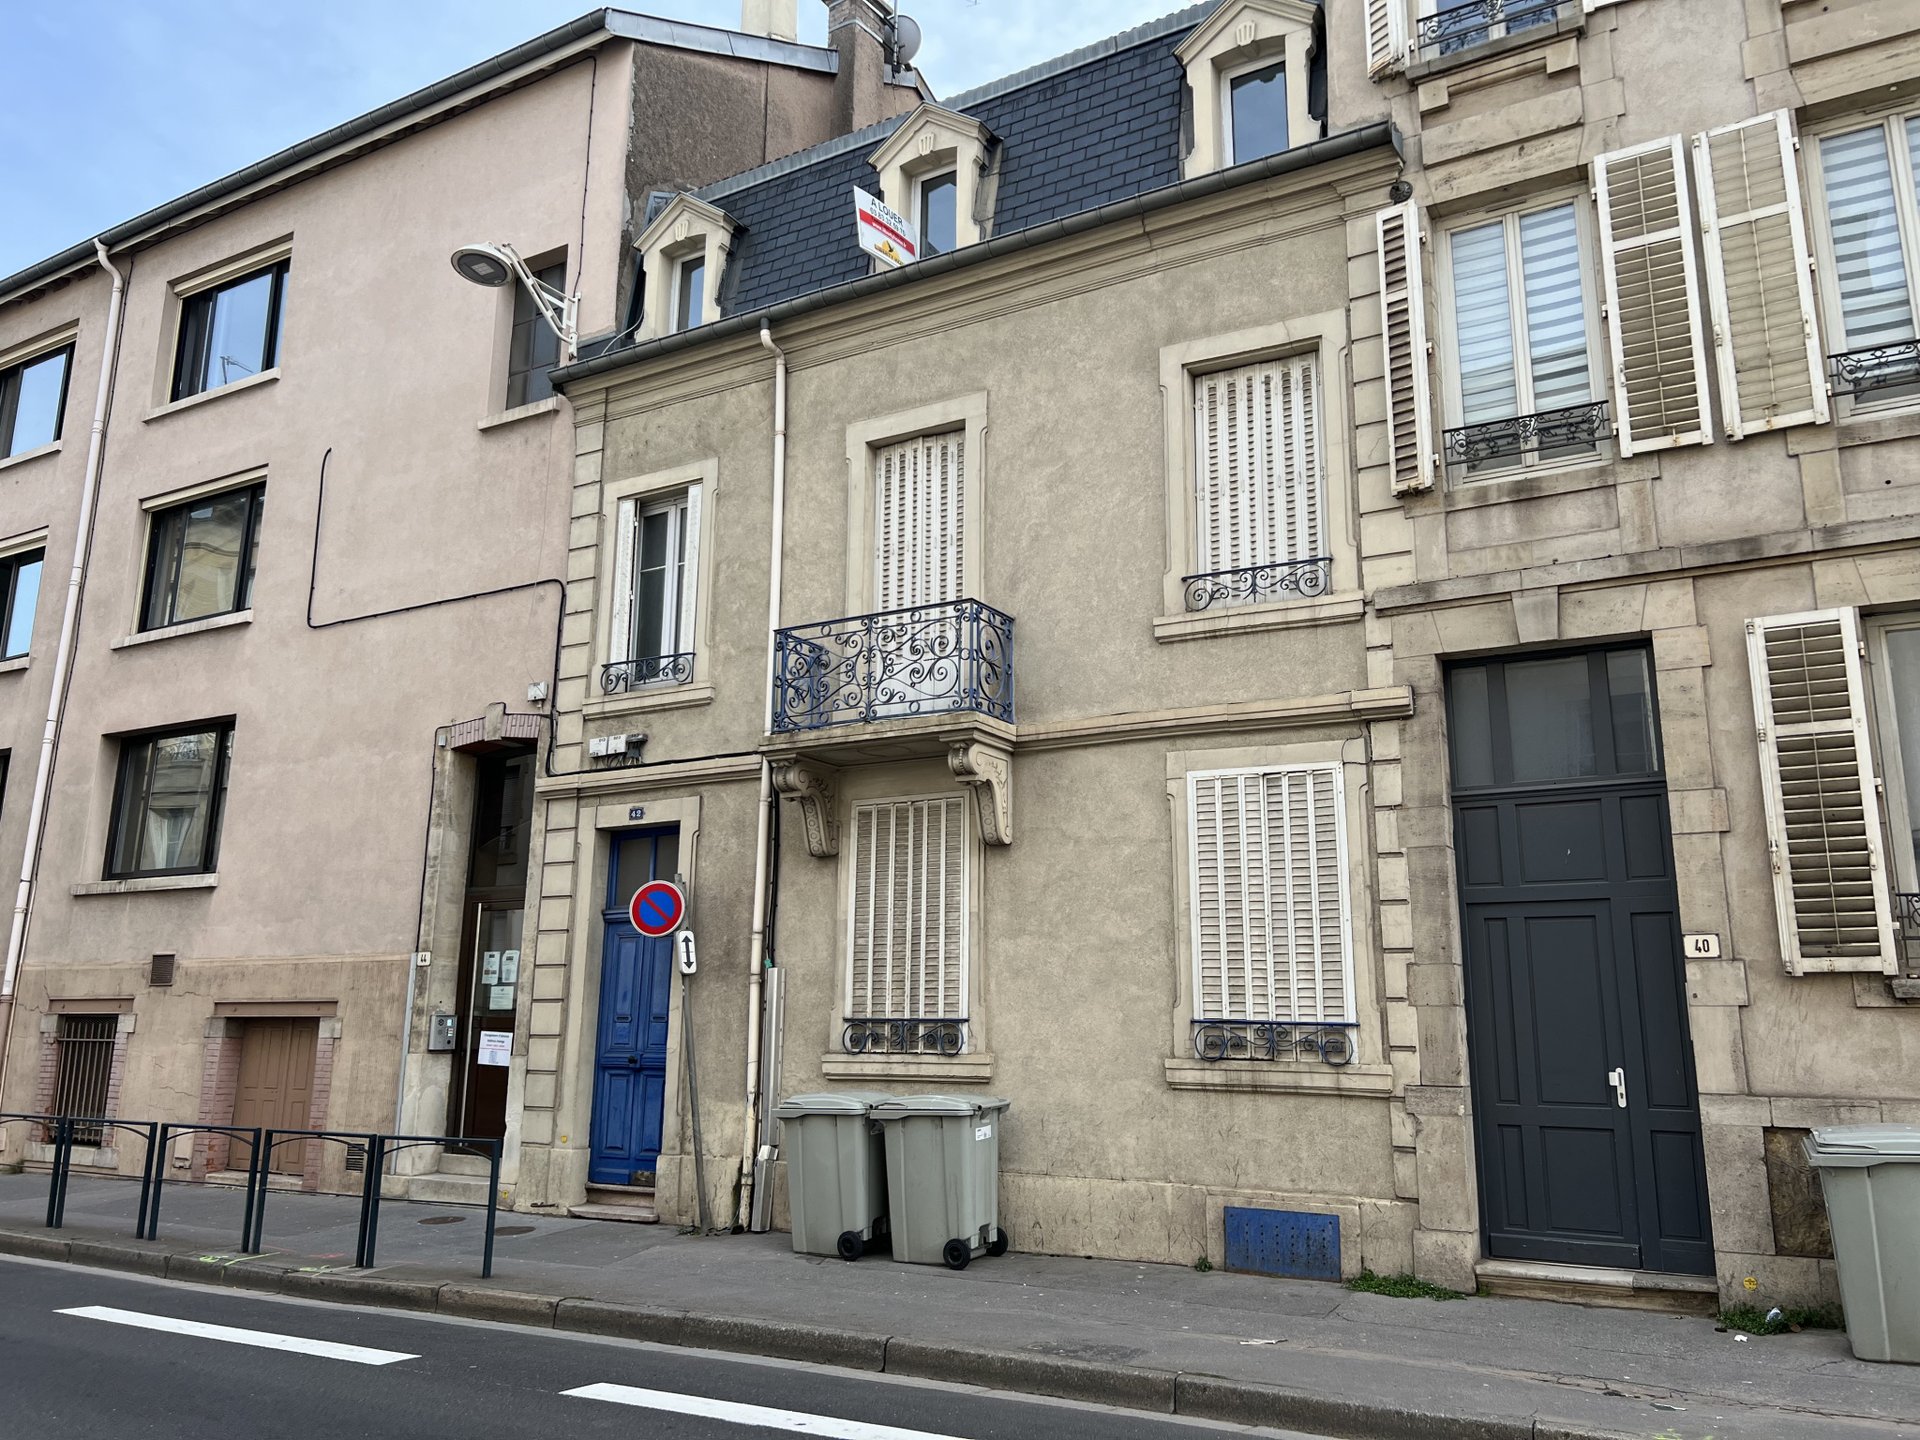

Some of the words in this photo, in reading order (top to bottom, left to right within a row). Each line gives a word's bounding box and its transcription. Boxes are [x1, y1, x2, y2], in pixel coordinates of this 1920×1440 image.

[871, 198, 877, 209] A
[878, 202, 904, 228] LOUER
[631, 809, 642, 818] 42
[1695, 939, 1710, 953] 40
[420, 953, 427, 963] 44
